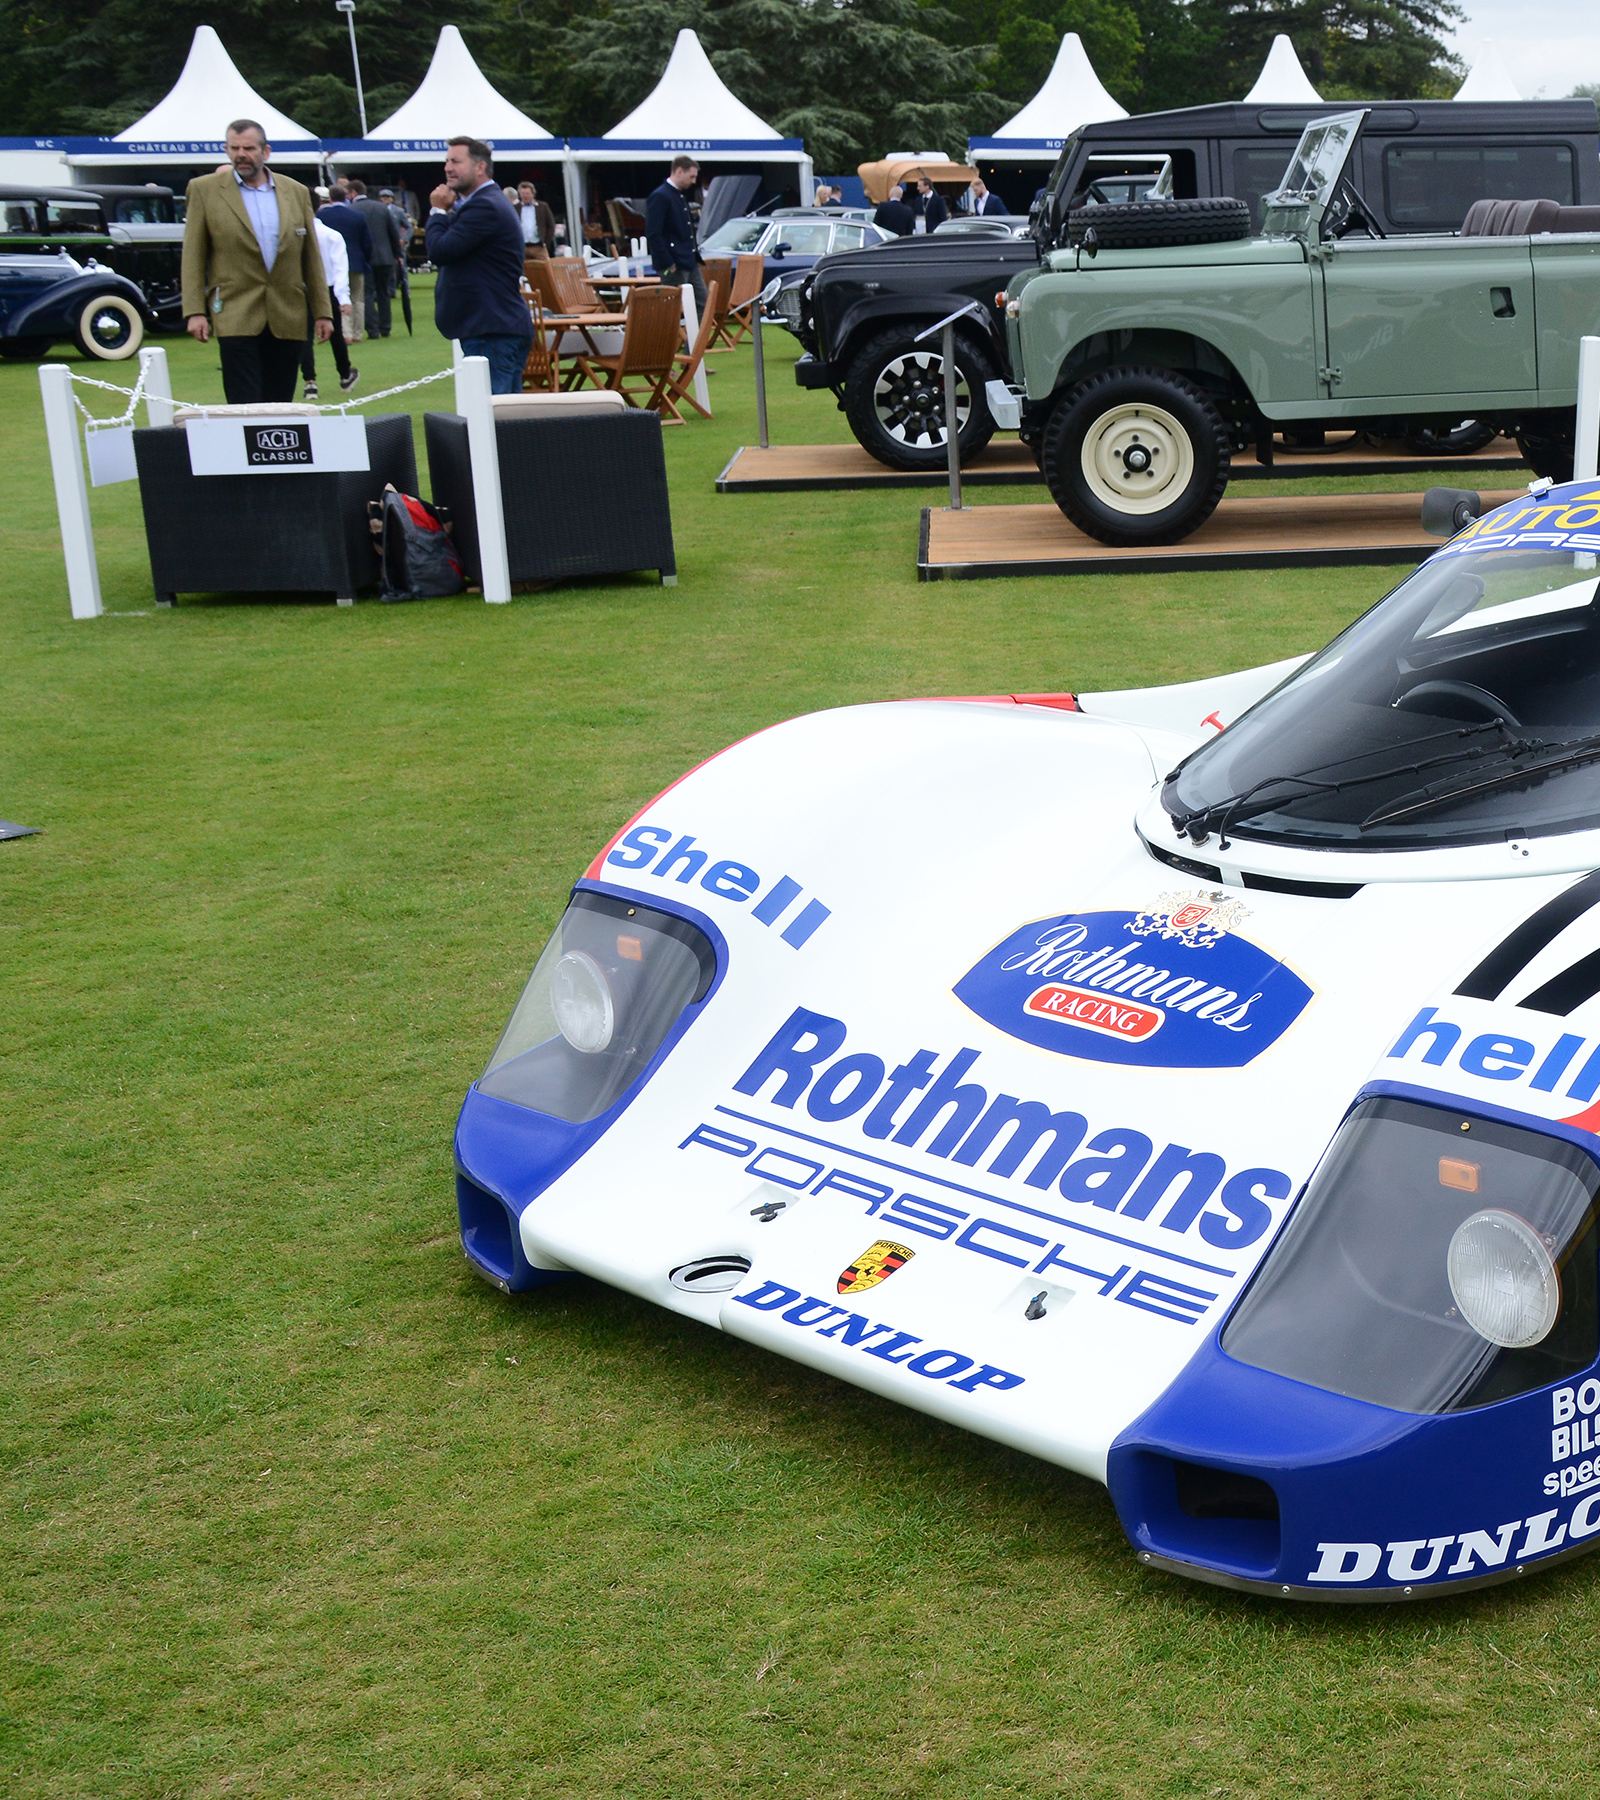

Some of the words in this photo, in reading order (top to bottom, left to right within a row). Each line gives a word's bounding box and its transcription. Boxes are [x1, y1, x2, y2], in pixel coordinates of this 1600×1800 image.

[35, 140, 54, 148] WC
[393, 141, 409, 150] DK
[663, 140, 711, 149] PERAZZI
[261, 431, 295, 447] ACH
[252, 451, 308, 461] CLASSIC
[606, 825, 832, 951] Shell
[1000, 923, 1263, 1032] Rothmans
[1041, 990, 1144, 1032] RACING
[732, 1005, 1292, 1250] Rothmans
[677, 1122, 1219, 1326] PORSCHE
[874, 1241, 914, 1260] PORSCHE
[732, 1279, 1027, 1394] DUNLOP
